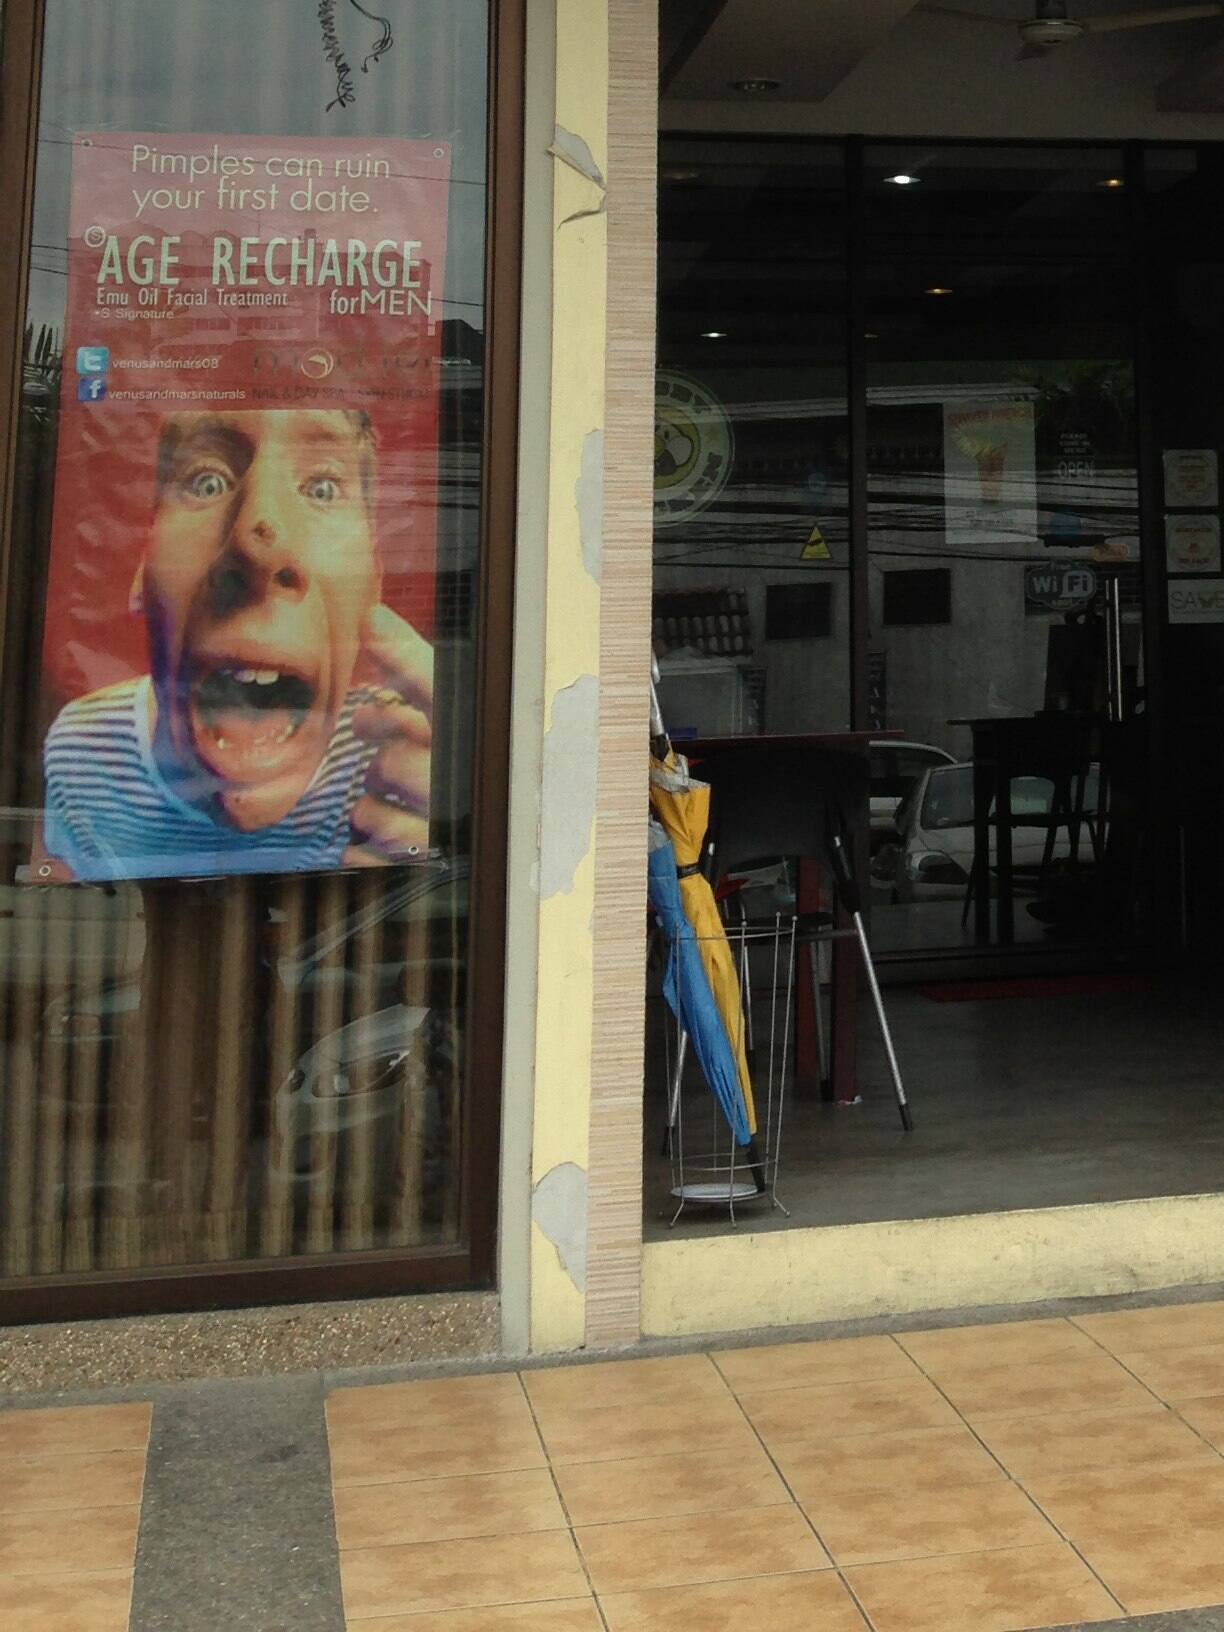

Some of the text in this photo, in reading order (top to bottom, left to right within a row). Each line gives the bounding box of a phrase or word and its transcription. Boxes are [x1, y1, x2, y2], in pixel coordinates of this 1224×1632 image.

[131, 144, 391, 183] Pimples can ruin
[131, 176, 379, 217] your first date.
[96, 235, 182, 285] AGE
[211, 237, 423, 288] RECHARGE
[96, 287, 288, 307] Emu Oil Facial Treatment
[116, 307, 174, 321] Signature
[112, 356, 219, 370] venusandmars08
[108, 387, 247, 402] venusandmarsnaturals
